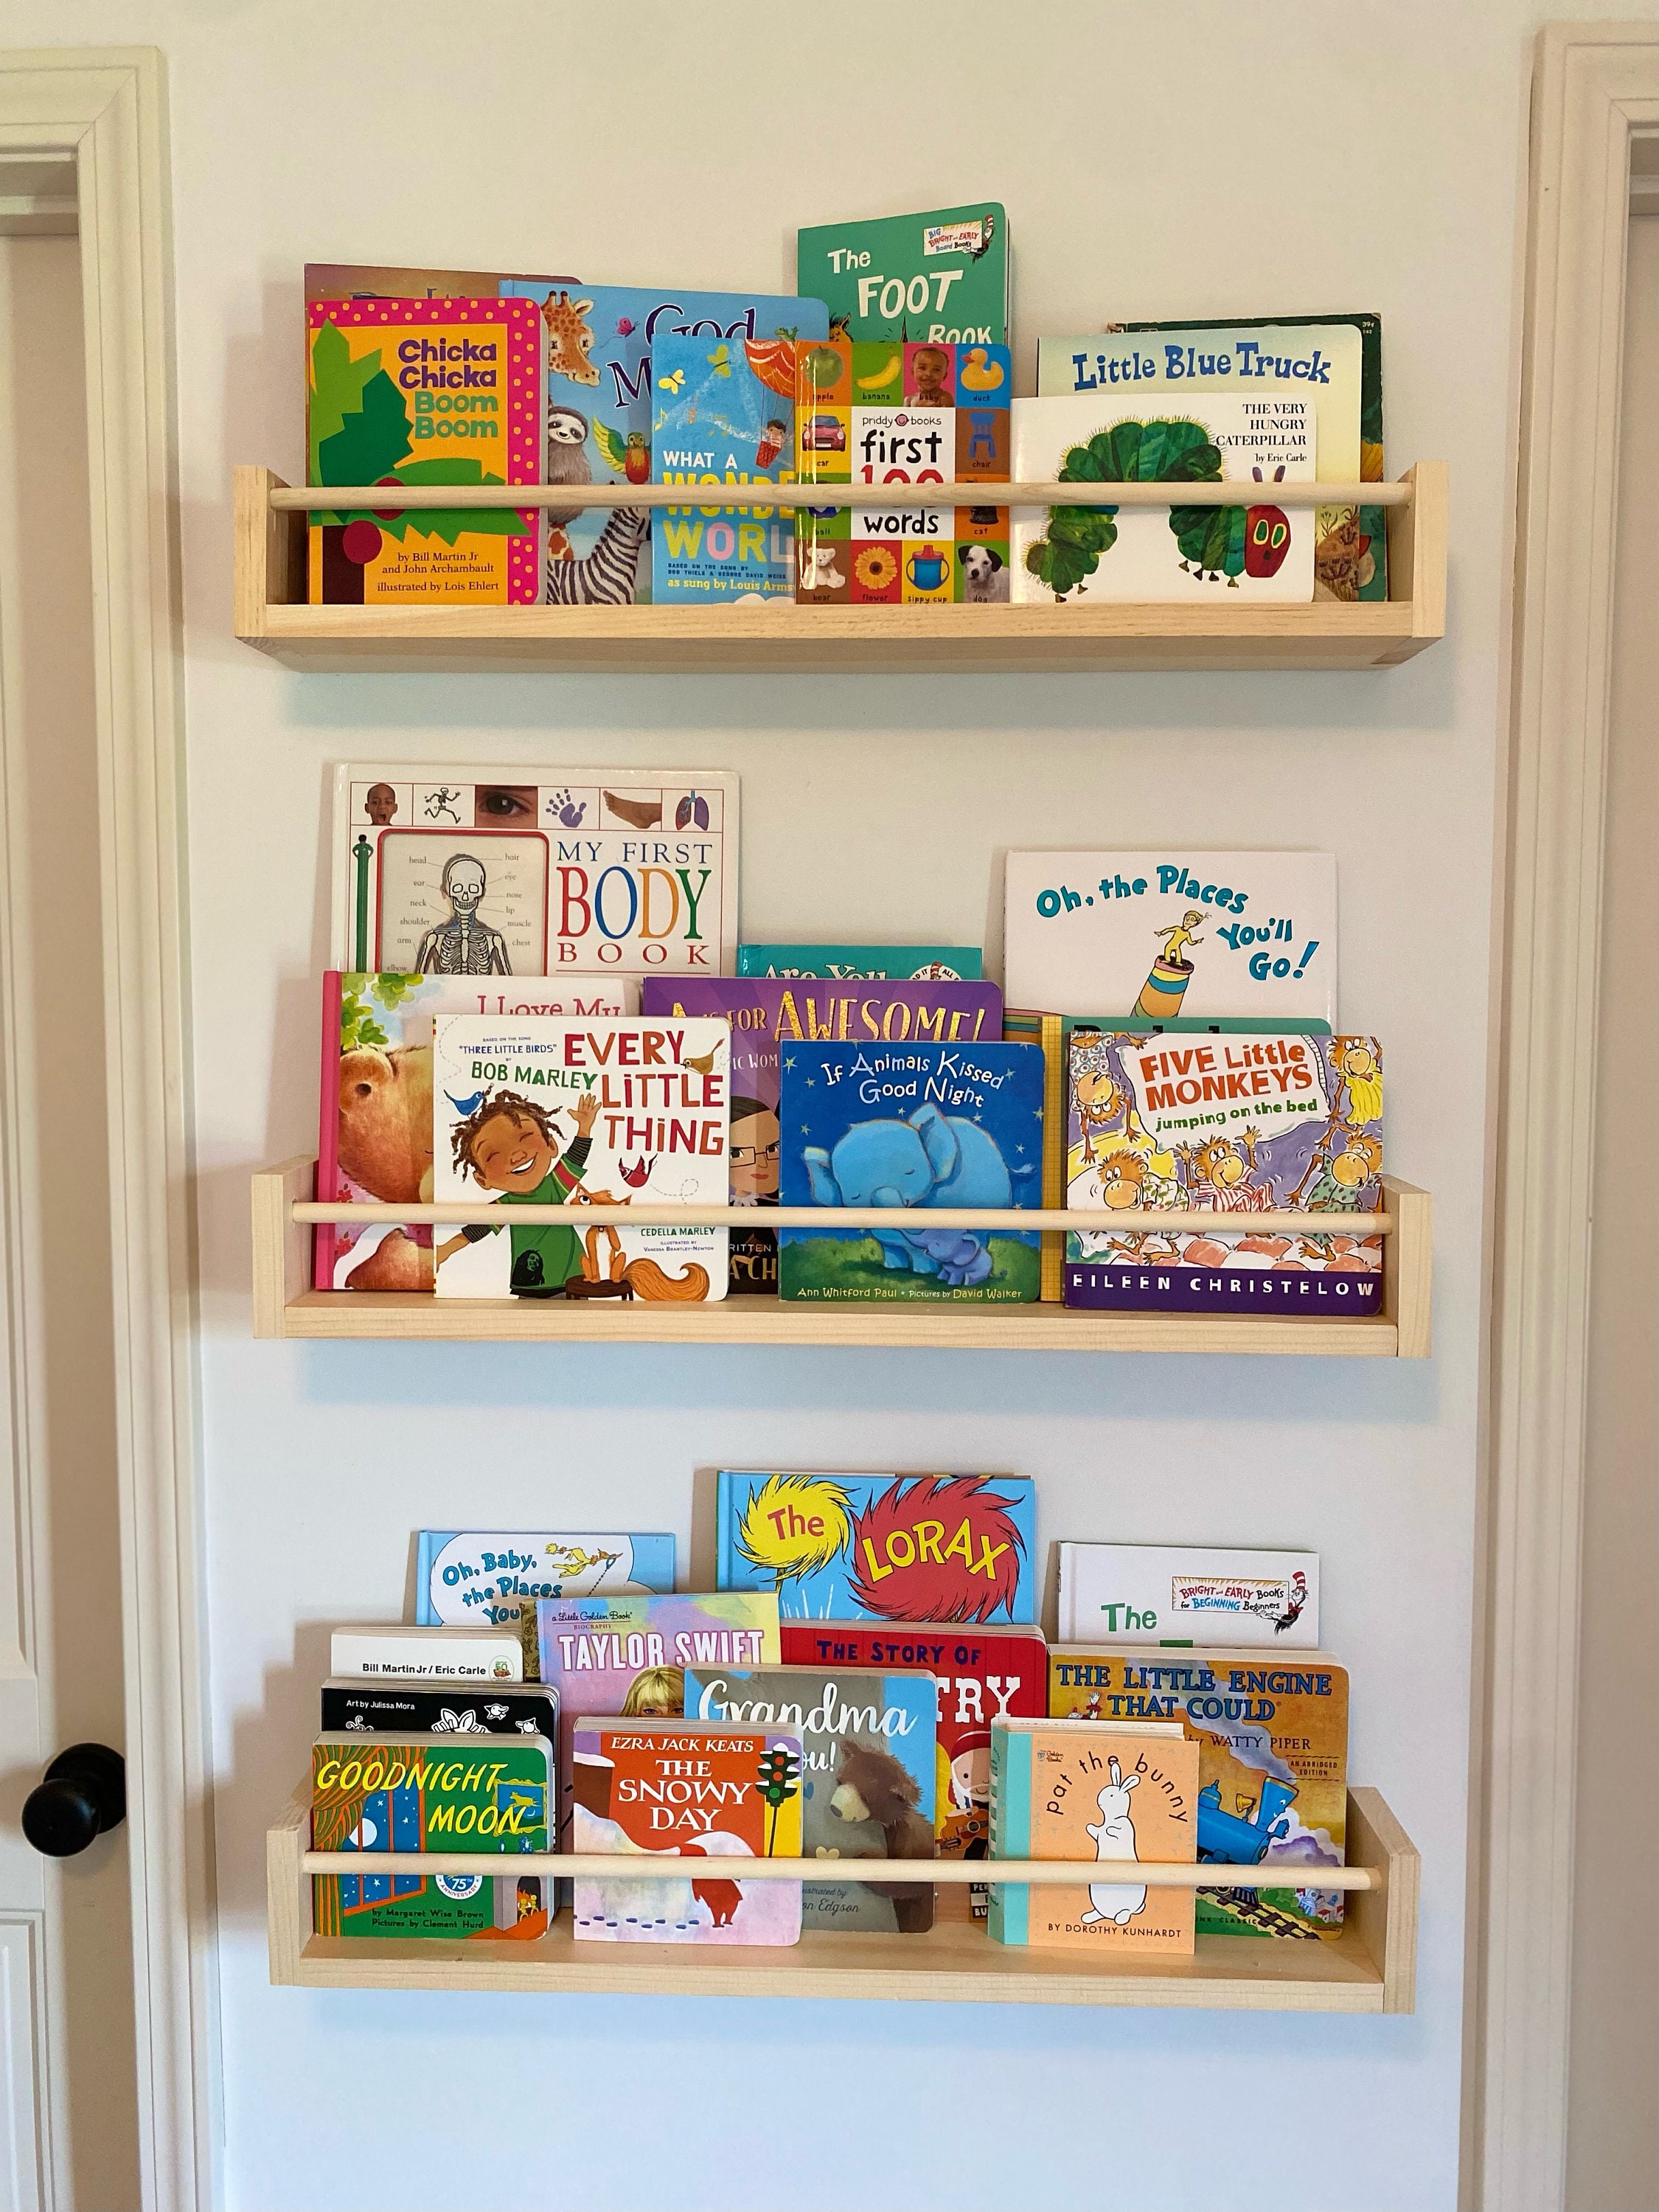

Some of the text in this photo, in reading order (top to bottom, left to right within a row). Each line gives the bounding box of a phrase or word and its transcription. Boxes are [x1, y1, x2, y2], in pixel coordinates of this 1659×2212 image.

[928, 229, 941, 239] BIG
[959, 232, 978, 240] EARLY
[827, 248, 871, 274] The
[858, 270, 964, 319] FOOT
[398, 338, 497, 362] Chicka
[399, 365, 496, 389] Chicka
[1072, 342, 1332, 391] Little Blue Truck
[414, 392, 499, 414] Boom
[1243, 403, 1307, 414] THE VERY
[414, 416, 498, 439] Boom
[862, 416, 941, 428] priddy books
[1250, 420, 1307, 430] HUNGRY
[860, 429, 942, 464] first
[1216, 435, 1307, 446] CATERPILLAR
[663, 451, 737, 470] WHAT A
[1256, 453, 1307, 462] by Eric Carle
[864, 510, 939, 535] words
[974, 527, 988, 535] cat
[397, 552, 479, 562] by Bill Martin Jr
[382, 563, 494, 574] and John Archambault
[378, 581, 499, 593] illustrated by Lois Ehlert
[684, 580, 710, 590] sung
[730, 580, 759, 590] Louis
[908, 596, 929, 604] sippy
[557, 841, 713, 864] MY FIRST
[1036, 865, 1248, 918] Oh, the Places
[557, 866, 712, 940] BODY
[1216, 918, 1292, 950] You'll
[1249, 941, 1319, 980] Go!
[942, 969, 953, 978] ALL
[495, 1046, 523, 1054] LITTLE
[565, 1031, 684, 1066] EVERY
[821, 1051, 1005, 1090] If Animals Kissed
[1139, 1040, 1306, 1082] FIVE Little
[471, 1062, 598, 1090] BOB MARLEY
[860, 1078, 984, 1107] Good Night
[1146, 1064, 1313, 1111] MONKEYS
[1155, 1099, 1318, 1132] jumping on the bed
[680, 1227, 715, 1236] MARLEY
[797, 1287, 819, 1297] Ann
[822, 1287, 871, 1297] Whitford
[874, 1288, 897, 1297] Paul
[908, 1289, 941, 1298] Pictures
[953, 1289, 983, 1298] David
[987, 1289, 1021, 1298] Walker
[1073, 1274, 1374, 1296] EILEEN CHRISTELOW
[768, 1504, 1010, 1584] The LORAX
[481, 1550, 537, 1573] Baby,
[462, 1576, 563, 1608] the Places
[1180, 1585, 1253, 1600] BRIGHT EARLY
[558, 1613, 579, 1621] Little
[580, 1611, 608, 1621] Golden
[1180, 1598, 1280, 1612] for BEGINNING Beginners
[1101, 1603, 1157, 1632] The
[558, 1631, 764, 1671] TAYLOR SWIFT
[817, 1641, 981, 1666] THE STORY OF
[363, 1663, 486, 1675] Bill Martin Jr Eric Carle
[1056, 1664, 1332, 1696] THE LITTLE ENGINE
[347, 1700, 415, 1710] Art by Julissa Mora
[1107, 1695, 1178, 1717] THAT
[611, 1736, 754, 1753] EZRA JACK KEATS
[1211, 1736, 1311, 1749] WATTY PIPER
[318, 1760, 508, 1792] GOODNIGHT
[655, 1759, 712, 1777] THE
[618, 1779, 752, 1805] SNOWY
[1046, 1751, 1188, 1823] pat the bunny
[428, 1804, 526, 1834] MOON
[649, 1807, 723, 1832] DAY
[372, 1908, 381, 1916] by
[386, 1909, 425, 1918] Margaret
[430, 1910, 452, 1918] Wise
[372, 1919, 404, 1927] Pictures
[410, 1920, 419, 1928] by
[422, 1920, 458, 1928] Clement
[1065, 1924, 1116, 1935] DOROTHY
[1123, 1928, 1181, 1938] KUNHARDT
